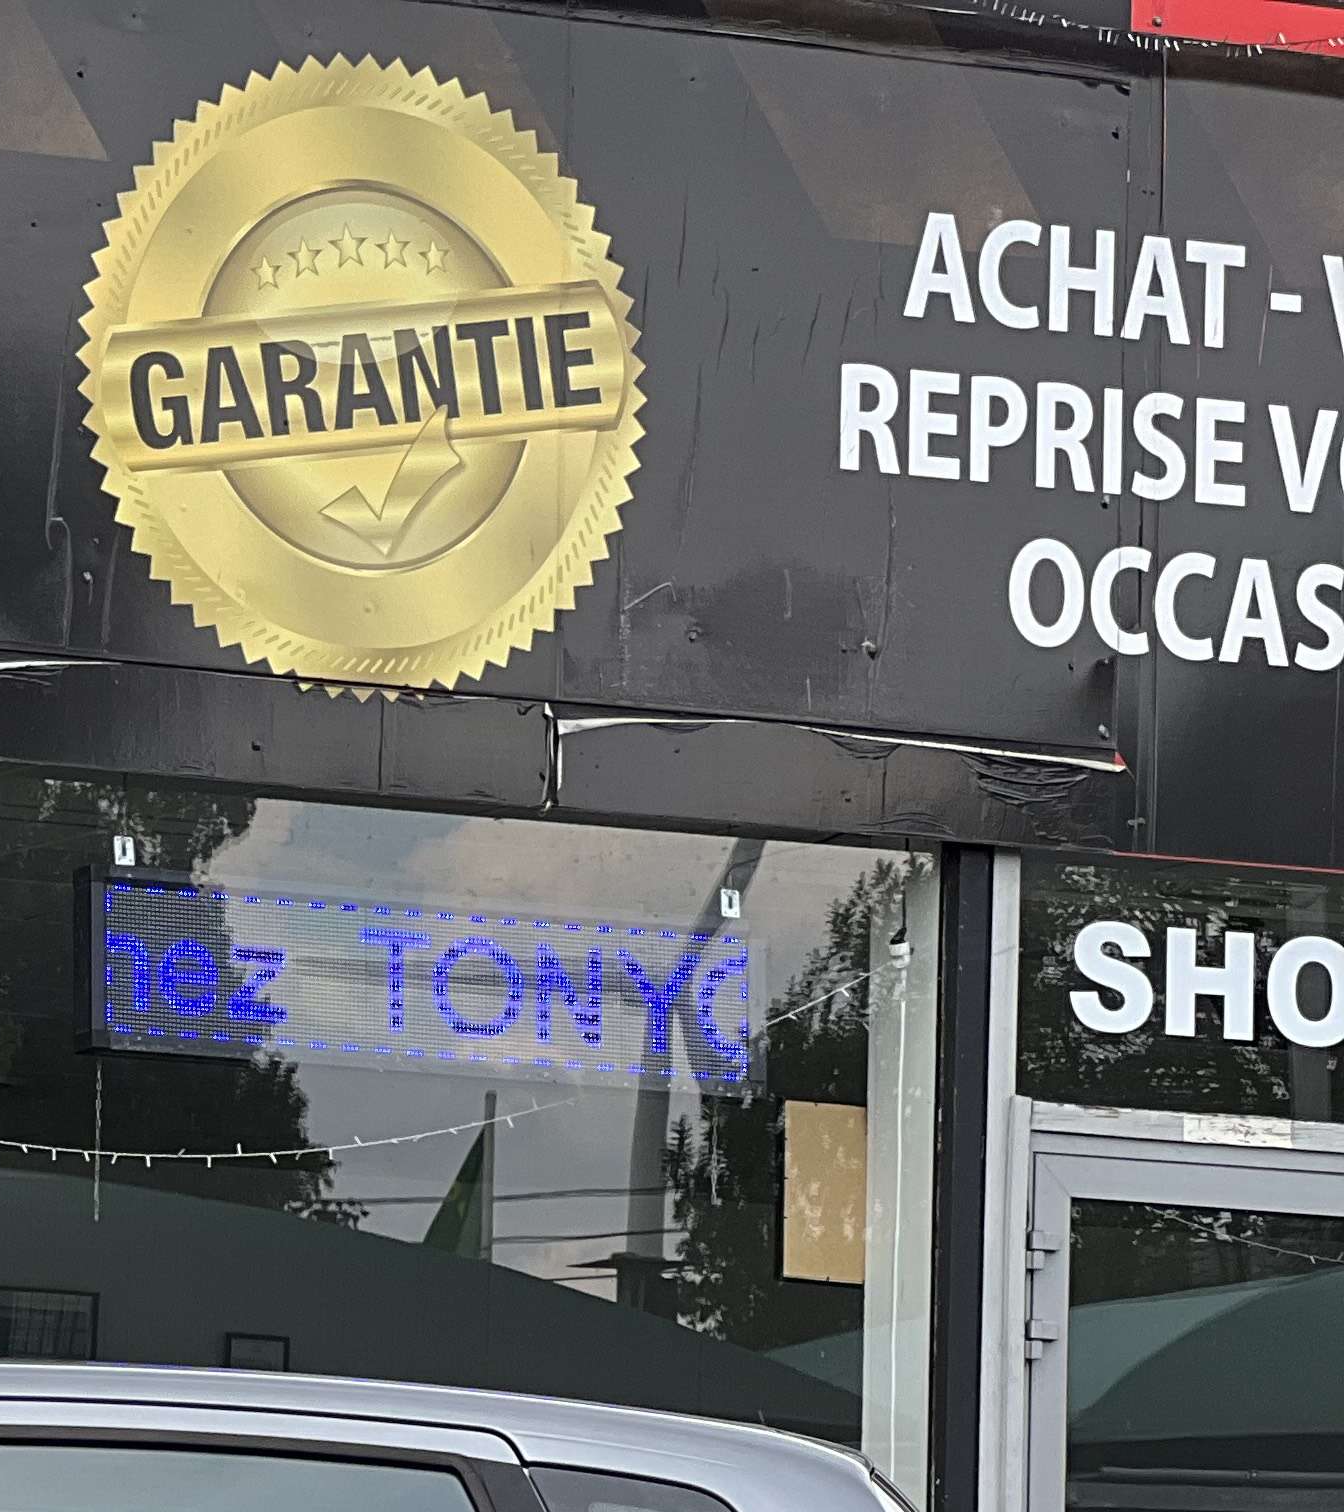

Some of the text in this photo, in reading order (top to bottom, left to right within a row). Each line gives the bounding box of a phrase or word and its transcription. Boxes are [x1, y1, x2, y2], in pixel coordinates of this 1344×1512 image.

[907, 211, 1247, 350] ACHAT
[129, 309, 604, 451] GARANTIE
[839, 362, 1344, 514] REPRISE V
[1069, 920, 1344, 1048] SHO
